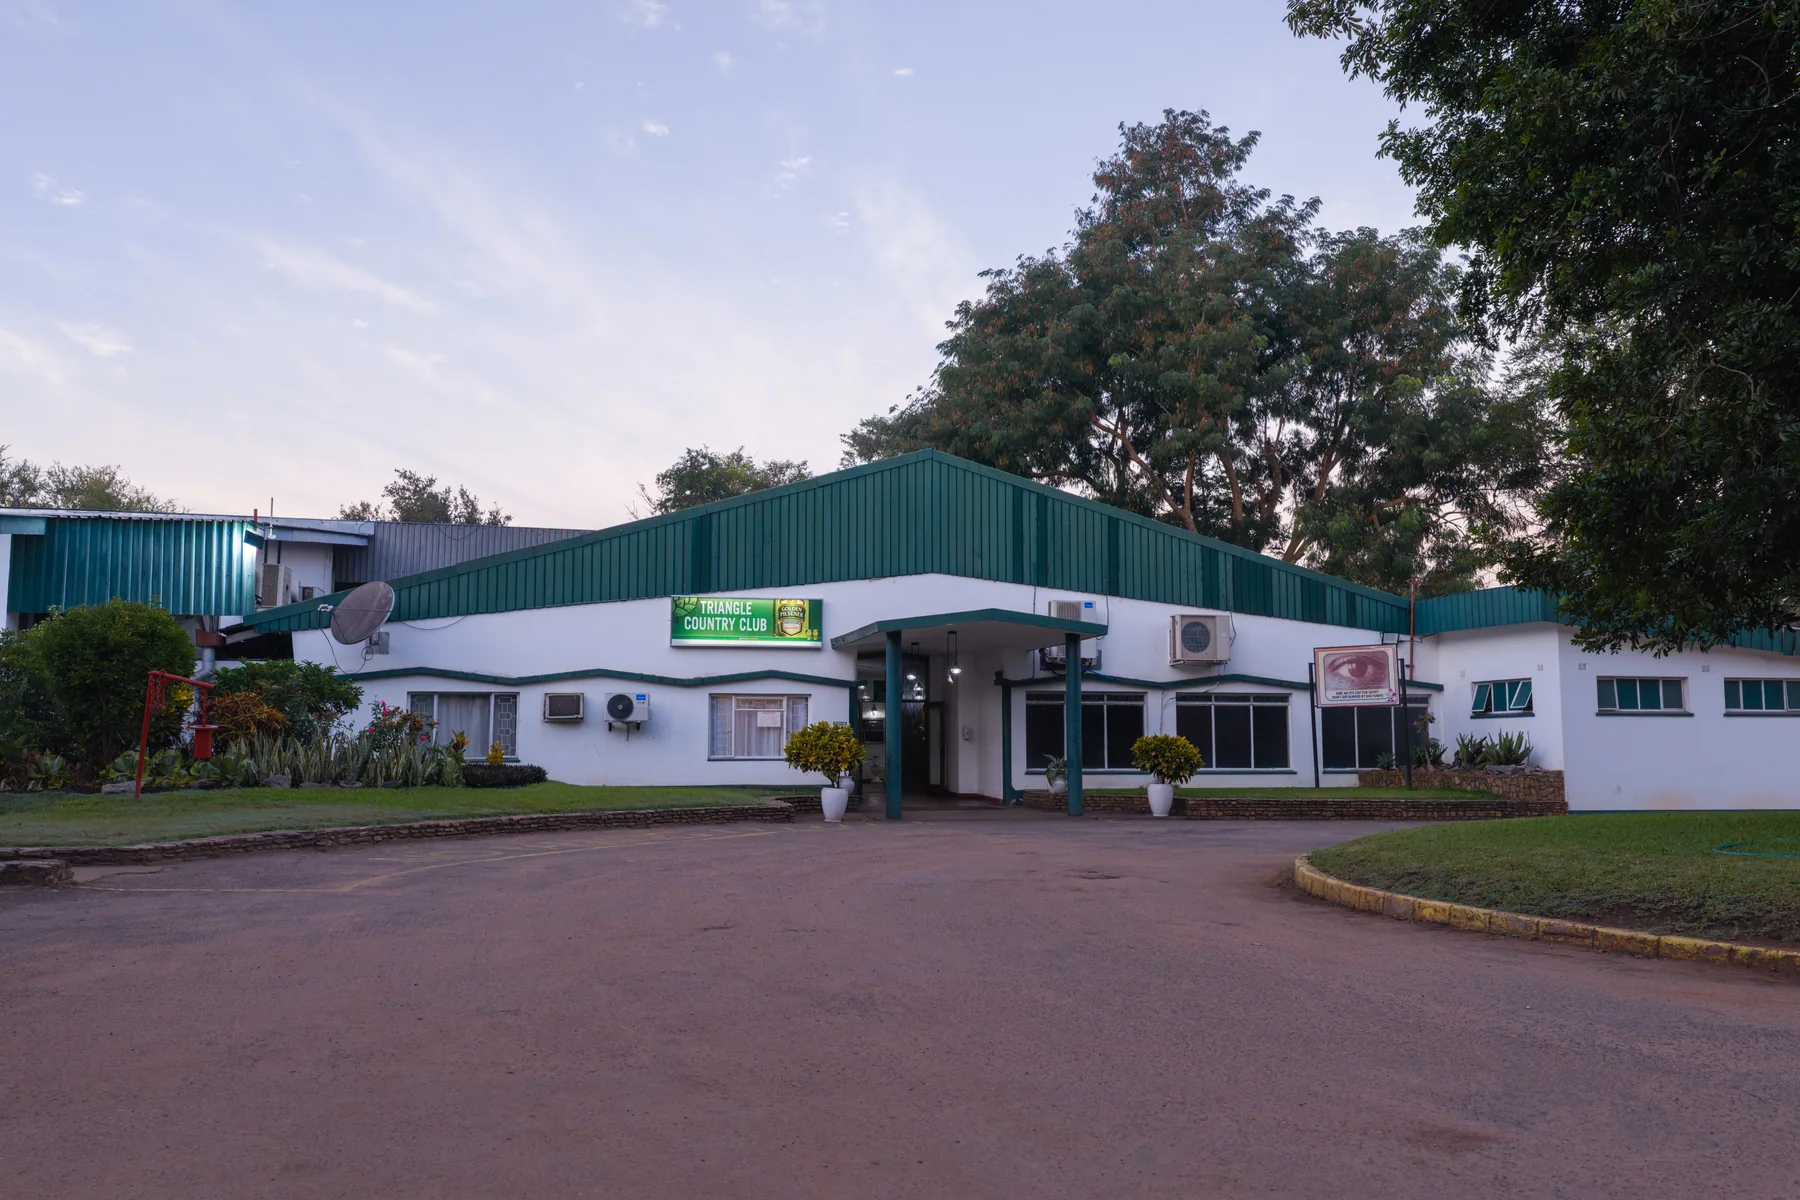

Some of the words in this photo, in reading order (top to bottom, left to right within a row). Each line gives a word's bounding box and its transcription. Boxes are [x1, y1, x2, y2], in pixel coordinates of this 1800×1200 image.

[700, 601, 752, 615] TRIANGLE
[684, 616, 736, 630] COUNTRY
[739, 618, 767, 631] CLUB
